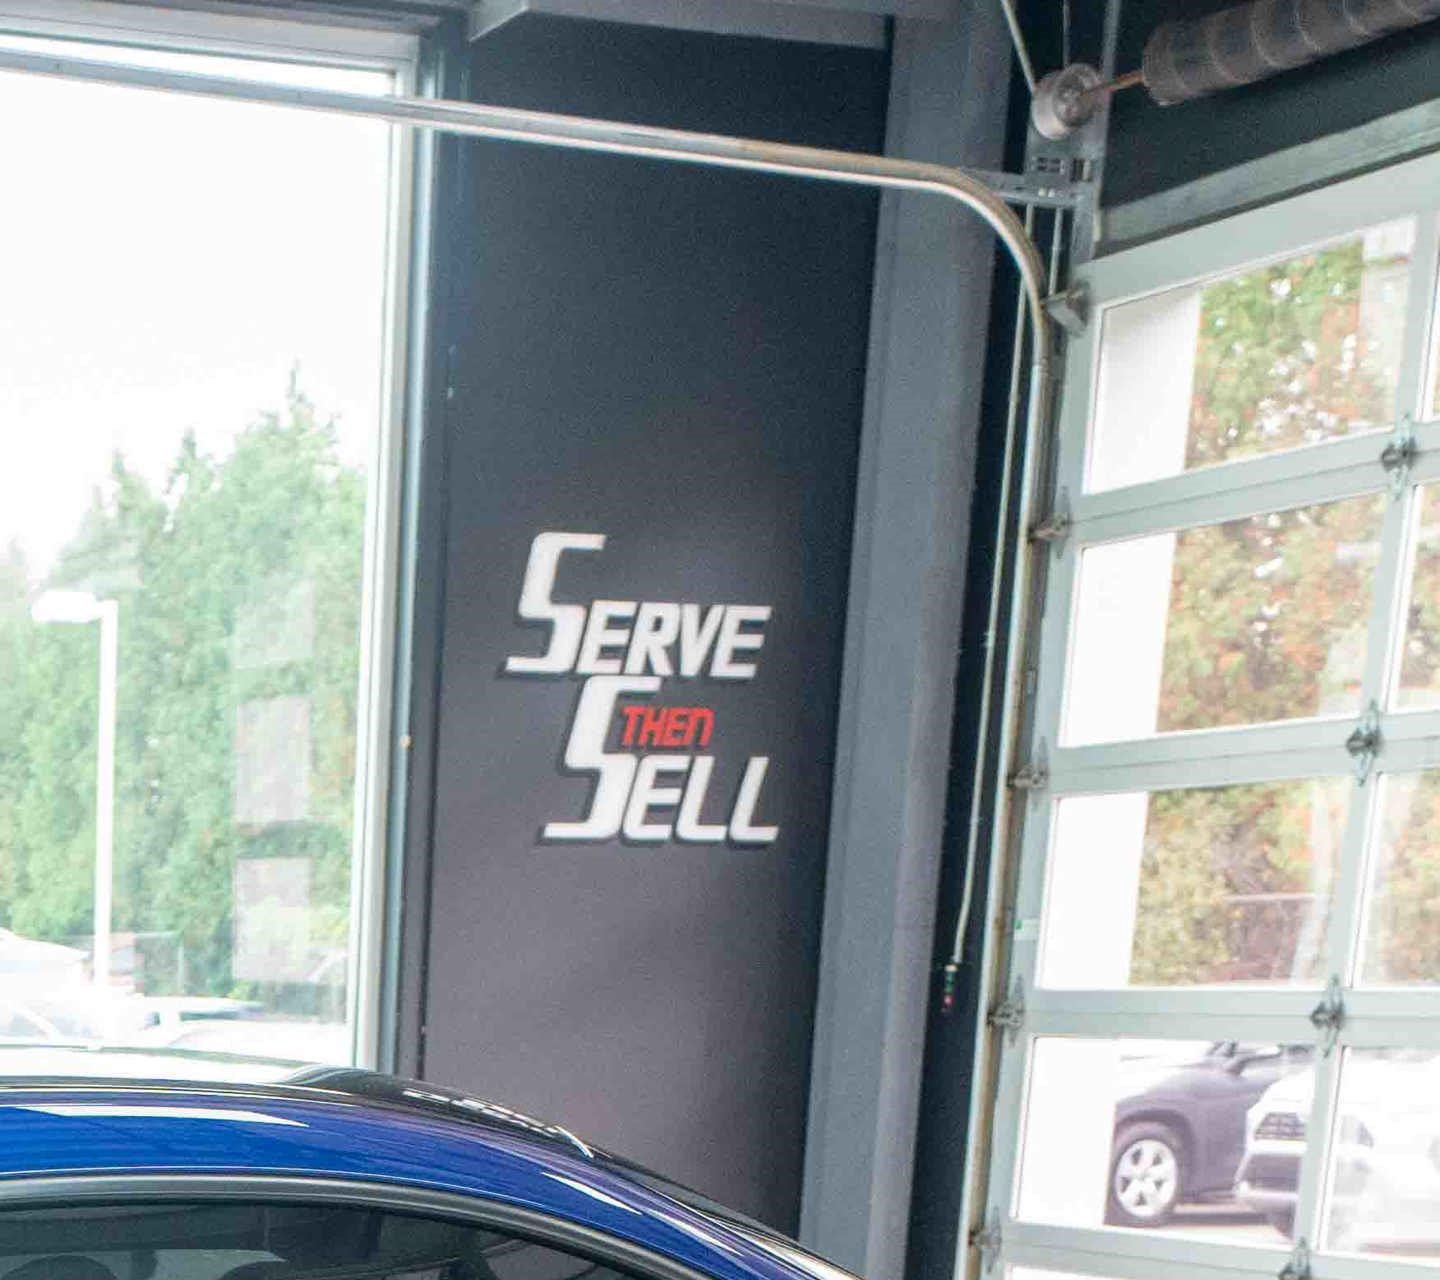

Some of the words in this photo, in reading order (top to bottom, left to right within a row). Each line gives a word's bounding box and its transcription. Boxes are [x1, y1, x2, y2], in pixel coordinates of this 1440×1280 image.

[505, 531, 773, 679] SERVE
[542, 674, 780, 842] SELL
[621, 705, 715, 747] THEN
